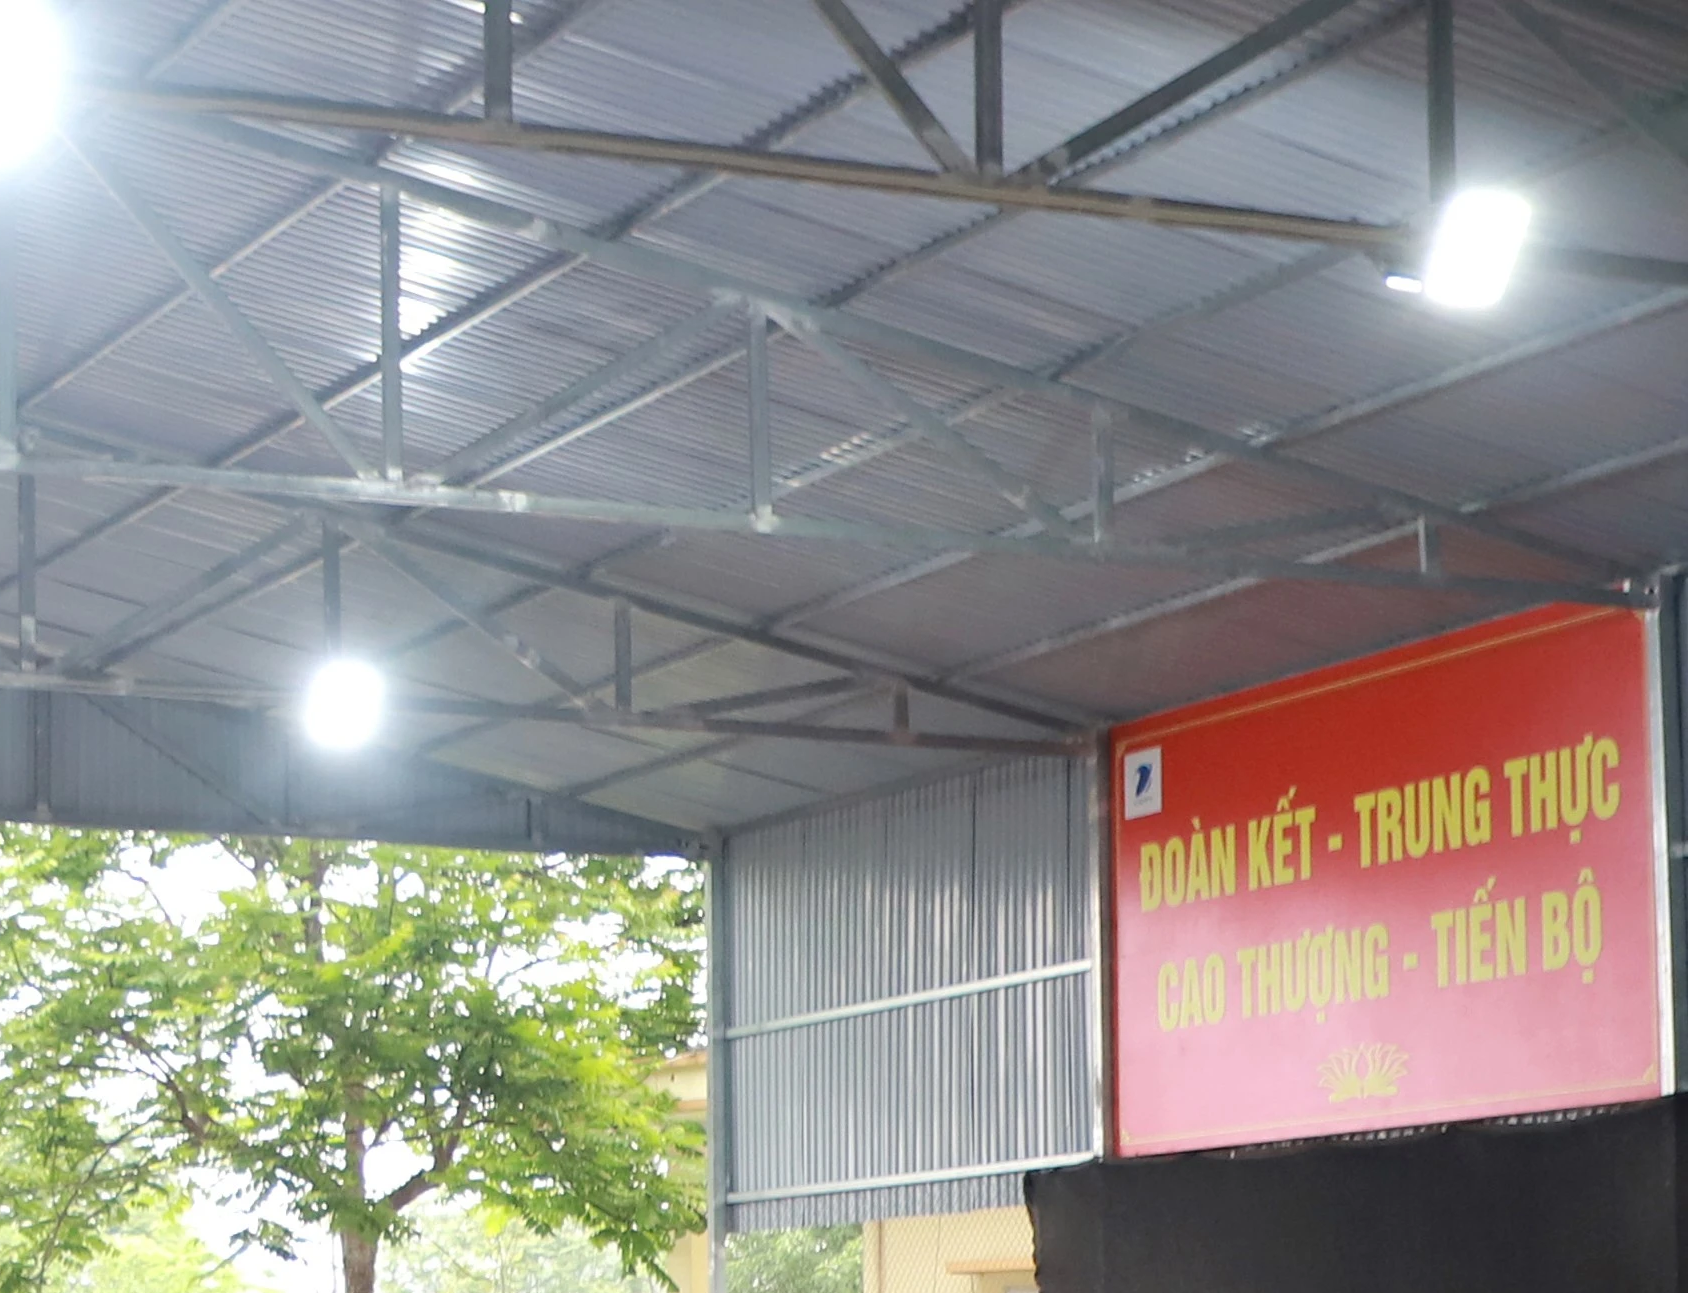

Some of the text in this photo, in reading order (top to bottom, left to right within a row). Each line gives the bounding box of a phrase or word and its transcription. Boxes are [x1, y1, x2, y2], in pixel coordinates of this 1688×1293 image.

[1140, 817, 1237, 912] ĐOÀN
[1248, 786, 1316, 894] KẾT
[1354, 767, 1492, 868] TRUNG
[1504, 731, 1621, 845] THỰC
[1156, 953, 1225, 1032] CAO
[1237, 922, 1389, 1023] THƯỢNG
[1430, 877, 1529, 988] TIẾN
[1542, 867, 1603, 984] BỘ
